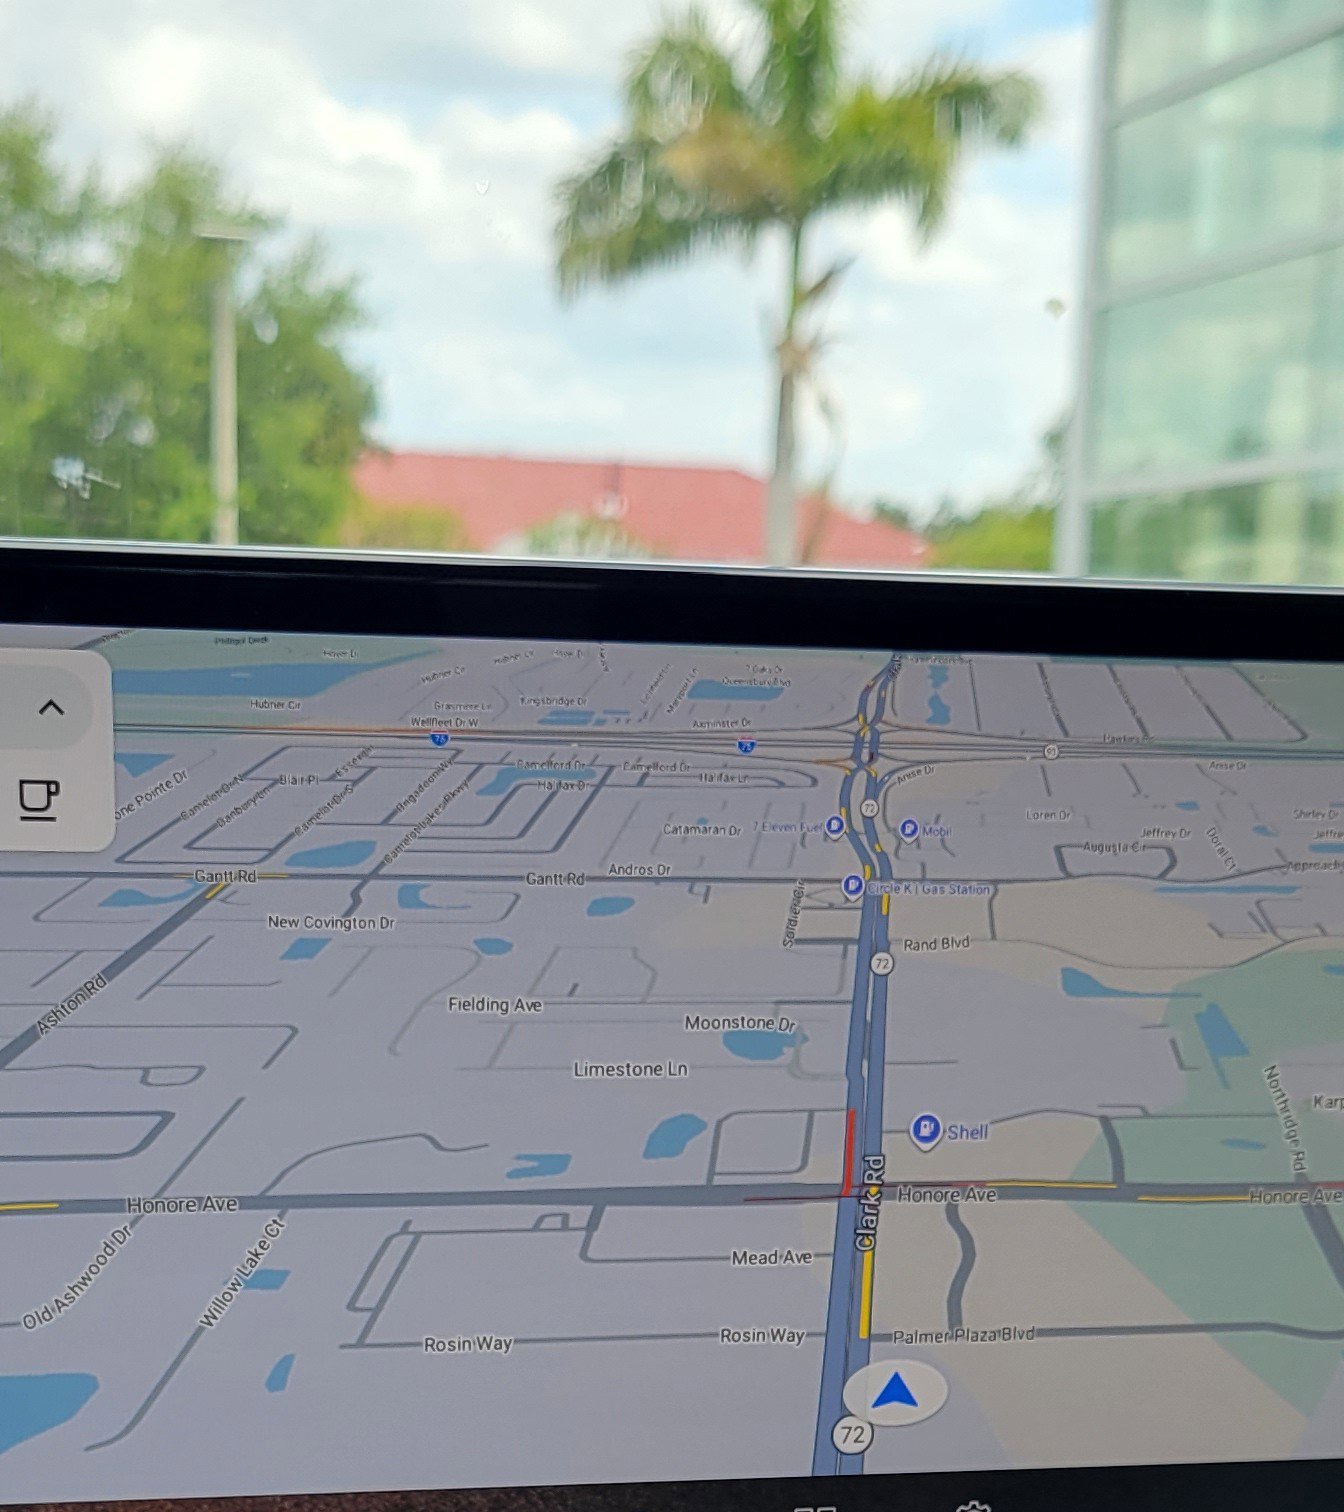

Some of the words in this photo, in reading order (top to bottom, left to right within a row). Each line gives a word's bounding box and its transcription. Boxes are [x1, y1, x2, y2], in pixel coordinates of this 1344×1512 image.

[250, 699, 285, 710] Hubner
[411, 716, 453, 727] Wellfleet
[455, 717, 467, 727] Dr
[468, 717, 479, 727] W
[172, 769, 188, 786] Dr
[864, 804, 875, 814] 72
[1059, 810, 1071, 820] Dr
[663, 823, 727, 836] Catamaran
[728, 825, 742, 836] Dr
[799, 822, 823, 833] Fuel
[922, 826, 953, 837] Mobil
[1141, 828, 1177, 840] Jeffrey
[1179, 828, 1192, 839] Dr
[1083, 842, 1129, 854] Augusta
[1206, 827, 1228, 859] Doral
[194, 868, 235, 883] Gantt
[238, 869, 257, 883] Rd
[608, 863, 653, 876] Andros
[656, 863, 671, 876] Dr
[525, 872, 565, 886] Gantt
[567, 872, 586, 885] Rd
[867, 882, 901, 894] Circle
[903, 882, 913, 894] K
[921, 883, 946, 895] Gas
[948, 883, 991, 895] Station
[267, 915, 299, 930] New
[303, 915, 377, 932] Covington
[379, 916, 395, 930] Dr
[903, 938, 937, 952] Rand
[941, 935, 971, 949] Blvd
[876, 958, 890, 969] 72
[36, 985, 88, 1037] Ashton
[82, 973, 109, 1000] Rd
[448, 997, 509, 1014] Fielding
[513, 998, 543, 1013] Ave
[685, 1015, 775, 1032] Moonstone
[778, 1018, 796, 1033] Dr
[573, 1061, 664, 1078] Limestone
[667, 1062, 688, 1077] Ln
[1264, 1064, 1302, 1150] Northridge
[1293, 1150, 1307, 1173] Rd
[947, 1124, 989, 1140] Shell
[864, 1154, 885, 1185] Rd
[897, 1187, 960, 1203] Honore
[965, 1186, 997, 1202] Ave
[1249, 1189, 1309, 1204] Honore
[1312, 1188, 1343, 1204] Ave
[127, 1196, 197, 1213] Honore
[202, 1196, 239, 1212] Ave
[855, 1191, 882, 1251] Clark
[731, 1250, 779, 1265] Mead
[782, 1250, 814, 1265] Ave
[22, 1306, 54, 1330] Old
[53, 1241, 117, 1314] Ashwood
[111, 1223, 134, 1248] Dr
[199, 1279, 244, 1329] Willow
[236, 1239, 271, 1278] Lake
[264, 1217, 286, 1241] Ct
[720, 1328, 766, 1343] Rosin
[767, 1328, 806, 1346] Way
[893, 1330, 951, 1345] Palmer
[954, 1327, 997, 1343] Plaza
[1001, 1326, 1035, 1342] Blvd
[423, 1336, 473, 1352] Rosin
[474, 1336, 514, 1355] Way
[839, 1426, 866, 1444] 72
